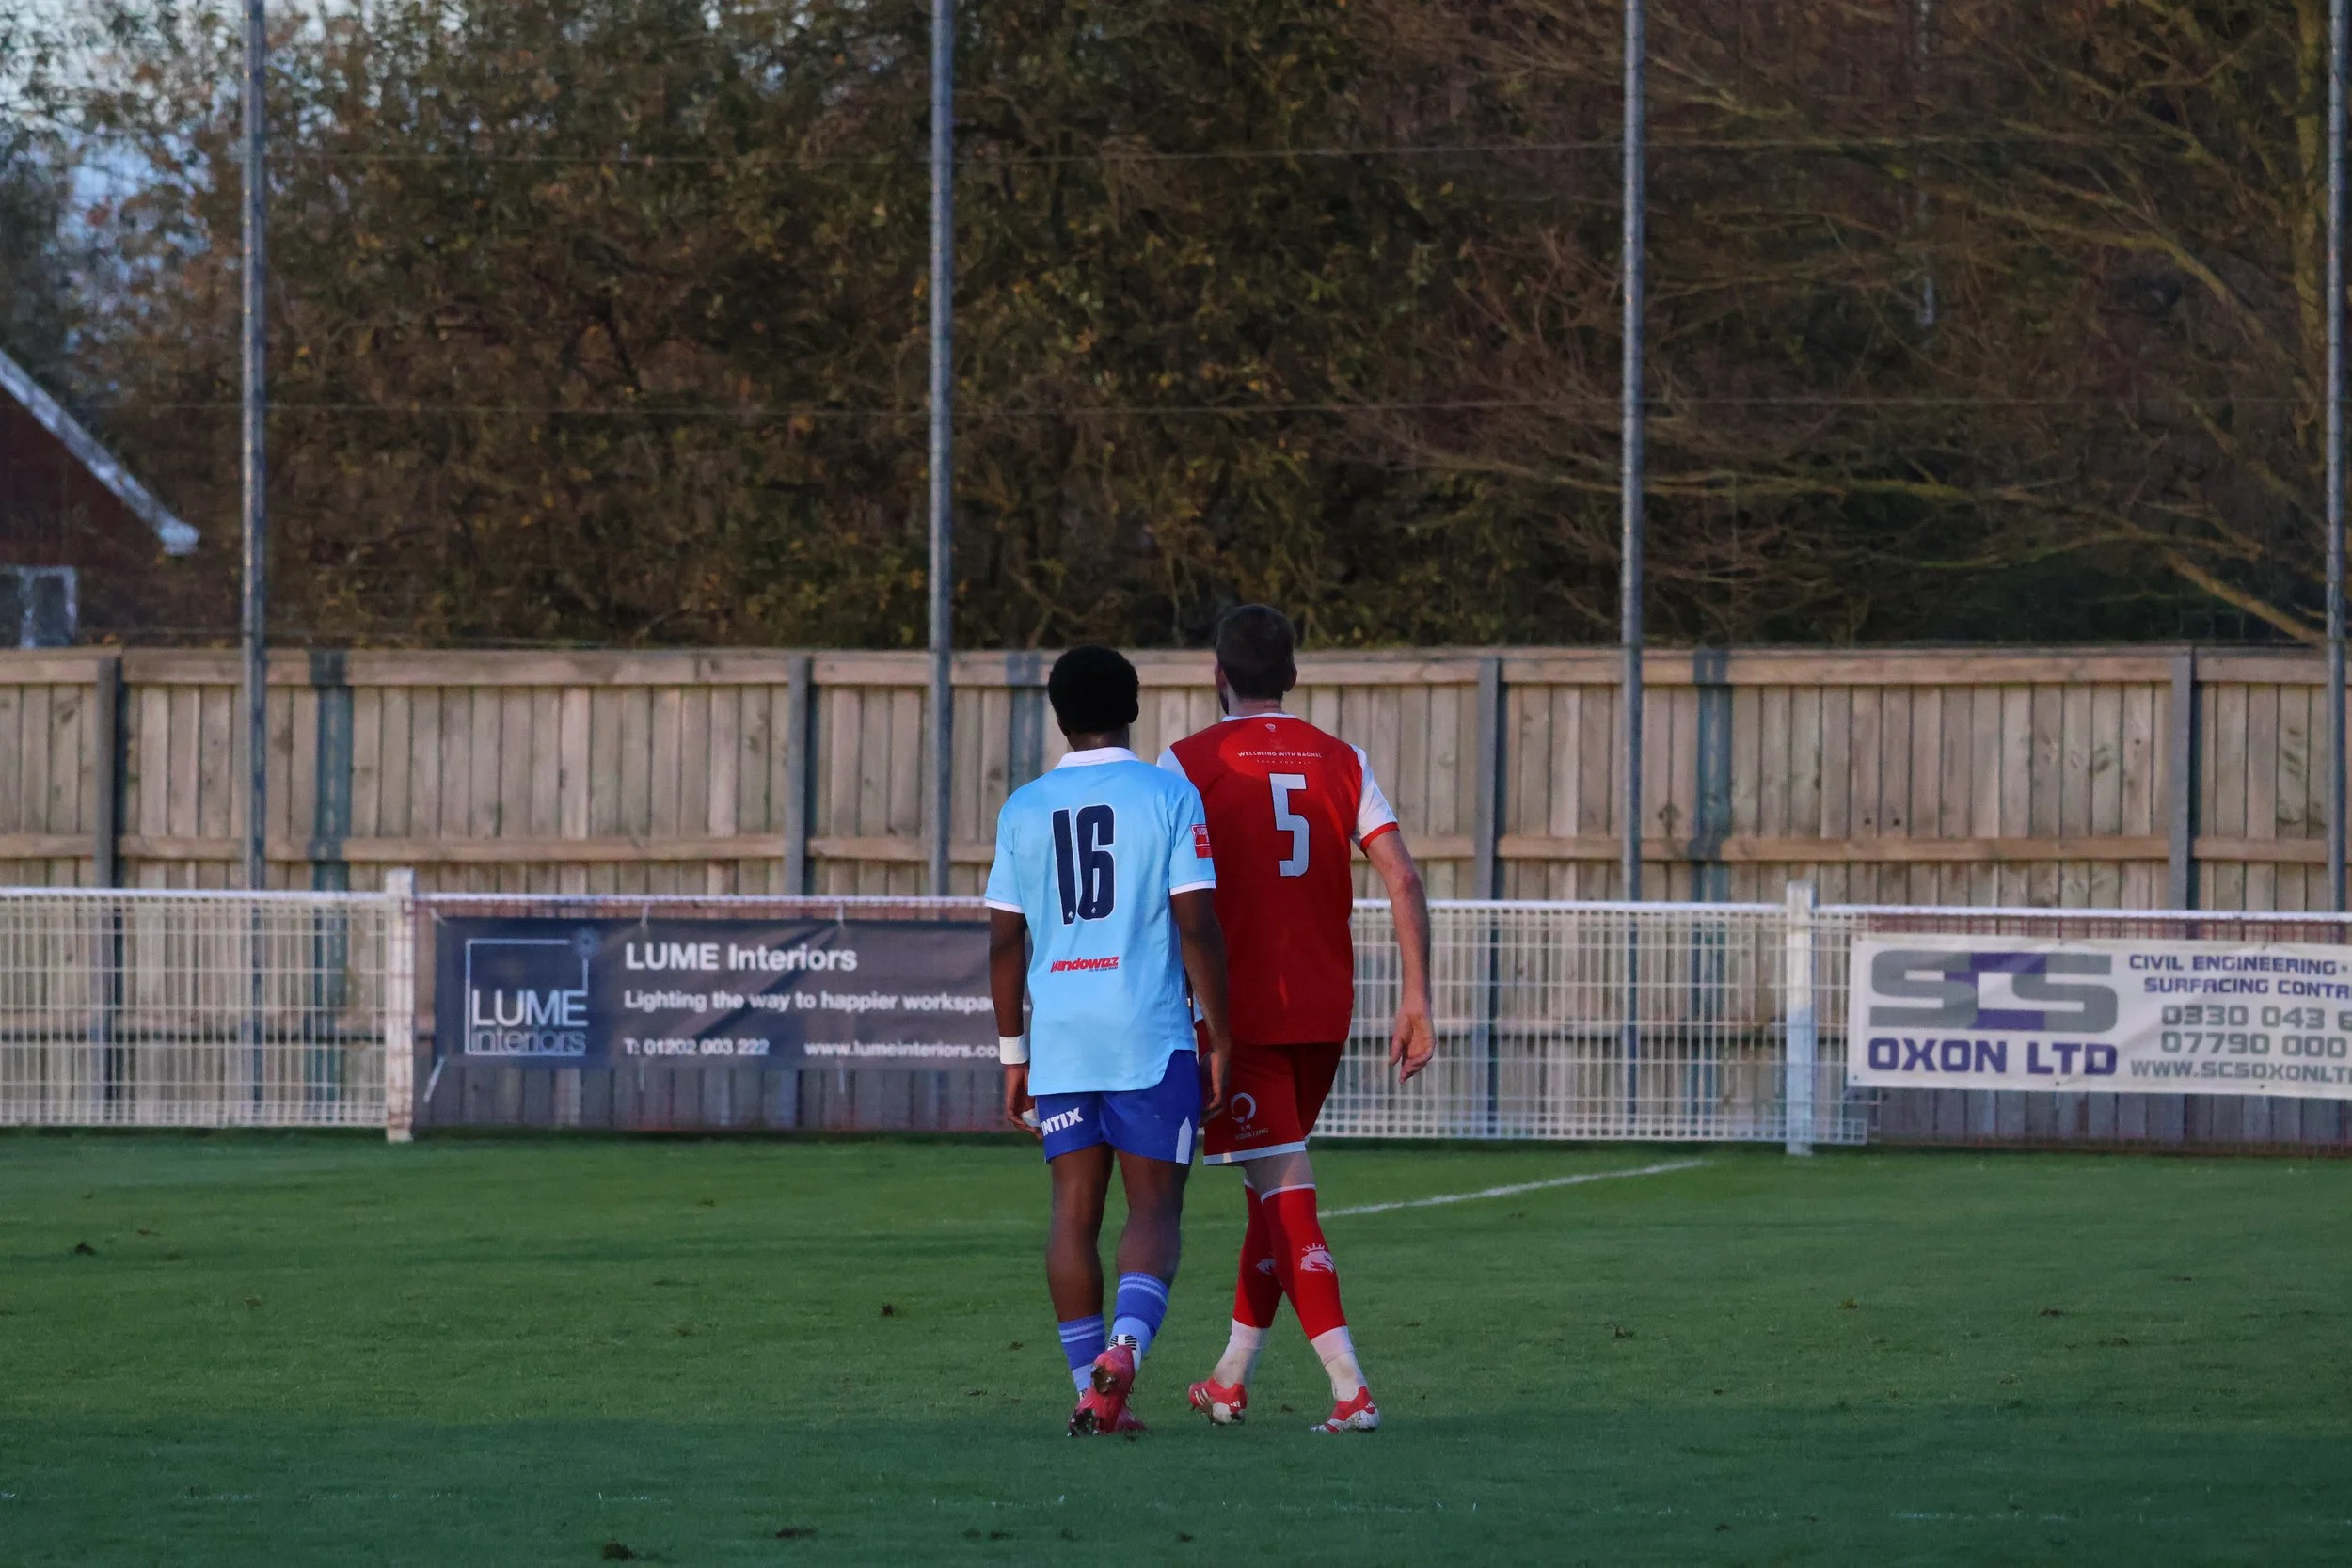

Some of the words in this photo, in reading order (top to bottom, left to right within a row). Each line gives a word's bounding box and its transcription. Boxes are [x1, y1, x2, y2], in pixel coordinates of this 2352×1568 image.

[1269, 773, 1310, 877] 5
[1052, 804, 1115, 925] 16
[626, 942, 720, 970] LUME
[728, 943, 858, 971] Interiors
[2129, 954, 2184, 971] CIVIL
[2192, 955, 2337, 976] ENGINEERING
[1869, 950, 2118, 1033] SCS
[2144, 976, 2269, 994] SURFACING
[2277, 979, 2352, 1000] CONTR
[471, 990, 589, 1026] LUME
[624, 990, 707, 1012] Lighting
[712, 990, 745, 1009] the
[749, 994, 790, 1012] way
[795, 991, 817, 1009] to
[820, 990, 898, 1013] happier
[901, 991, 994, 1015] workspa
[2161, 1005, 2249, 1027] 0330
[2261, 1006, 2326, 1030] 043
[471, 1024, 587, 1053] interiors
[624, 1038, 640, 1055] T:
[643, 1038, 697, 1055] 01202
[700, 1038, 733, 1055] 003
[738, 1038, 770, 1055] 222
[803, 1040, 999, 1058] www.lumeinteriors.co
[2161, 1031, 2270, 1055] 07790
[2282, 1034, 2347, 1059] 000
[1868, 1037, 2007, 1073] OXON
[2026, 1041, 2117, 1076] LTD
[2130, 1060, 2352, 1084] WWW.SCSOXONLT
